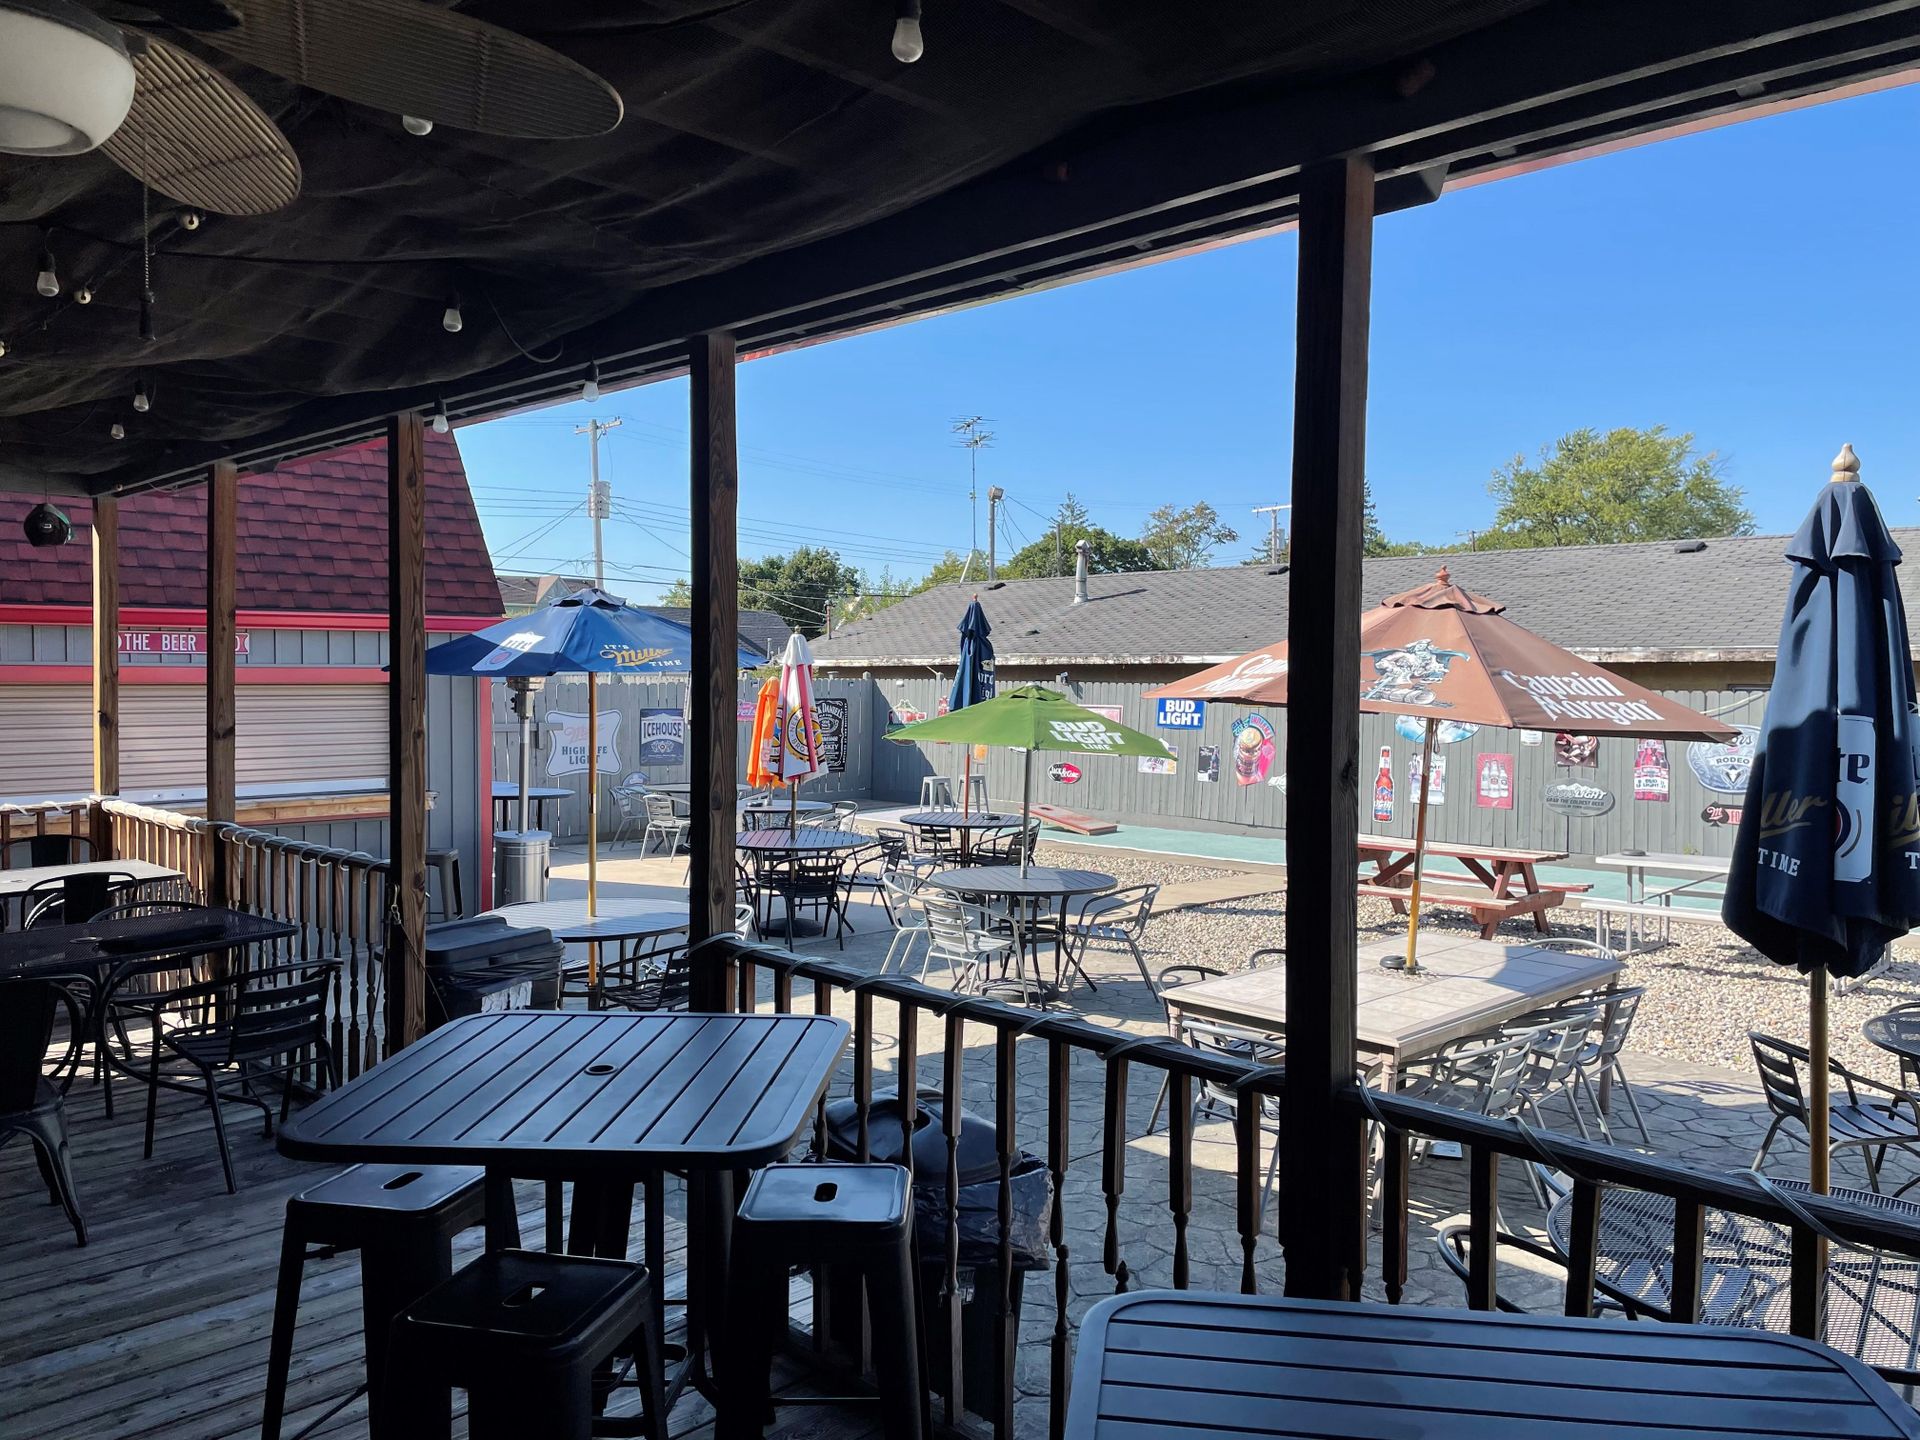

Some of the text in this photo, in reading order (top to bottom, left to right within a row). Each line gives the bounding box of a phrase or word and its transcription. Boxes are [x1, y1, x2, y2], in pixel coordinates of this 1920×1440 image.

[124, 633, 197, 651] THE BEER
[600, 647, 674, 667] Miller
[649, 659, 683, 667] TIME
[1501, 669, 1625, 700] Captain
[1165, 699, 1196, 712] BUD
[1530, 694, 1666, 726] Morgan
[1159, 712, 1200, 726] LIGHT
[643, 721, 681, 739] ICEHOUSE
[1048, 720, 1107, 733] BUD
[1049, 730, 1126, 745] LIGHT
[562, 746, 586, 755] HIGH
[1716, 757, 1750, 765] RODEO
[1574, 790, 1608, 800] LIGHT
[1758, 847, 1801, 877] TIME
